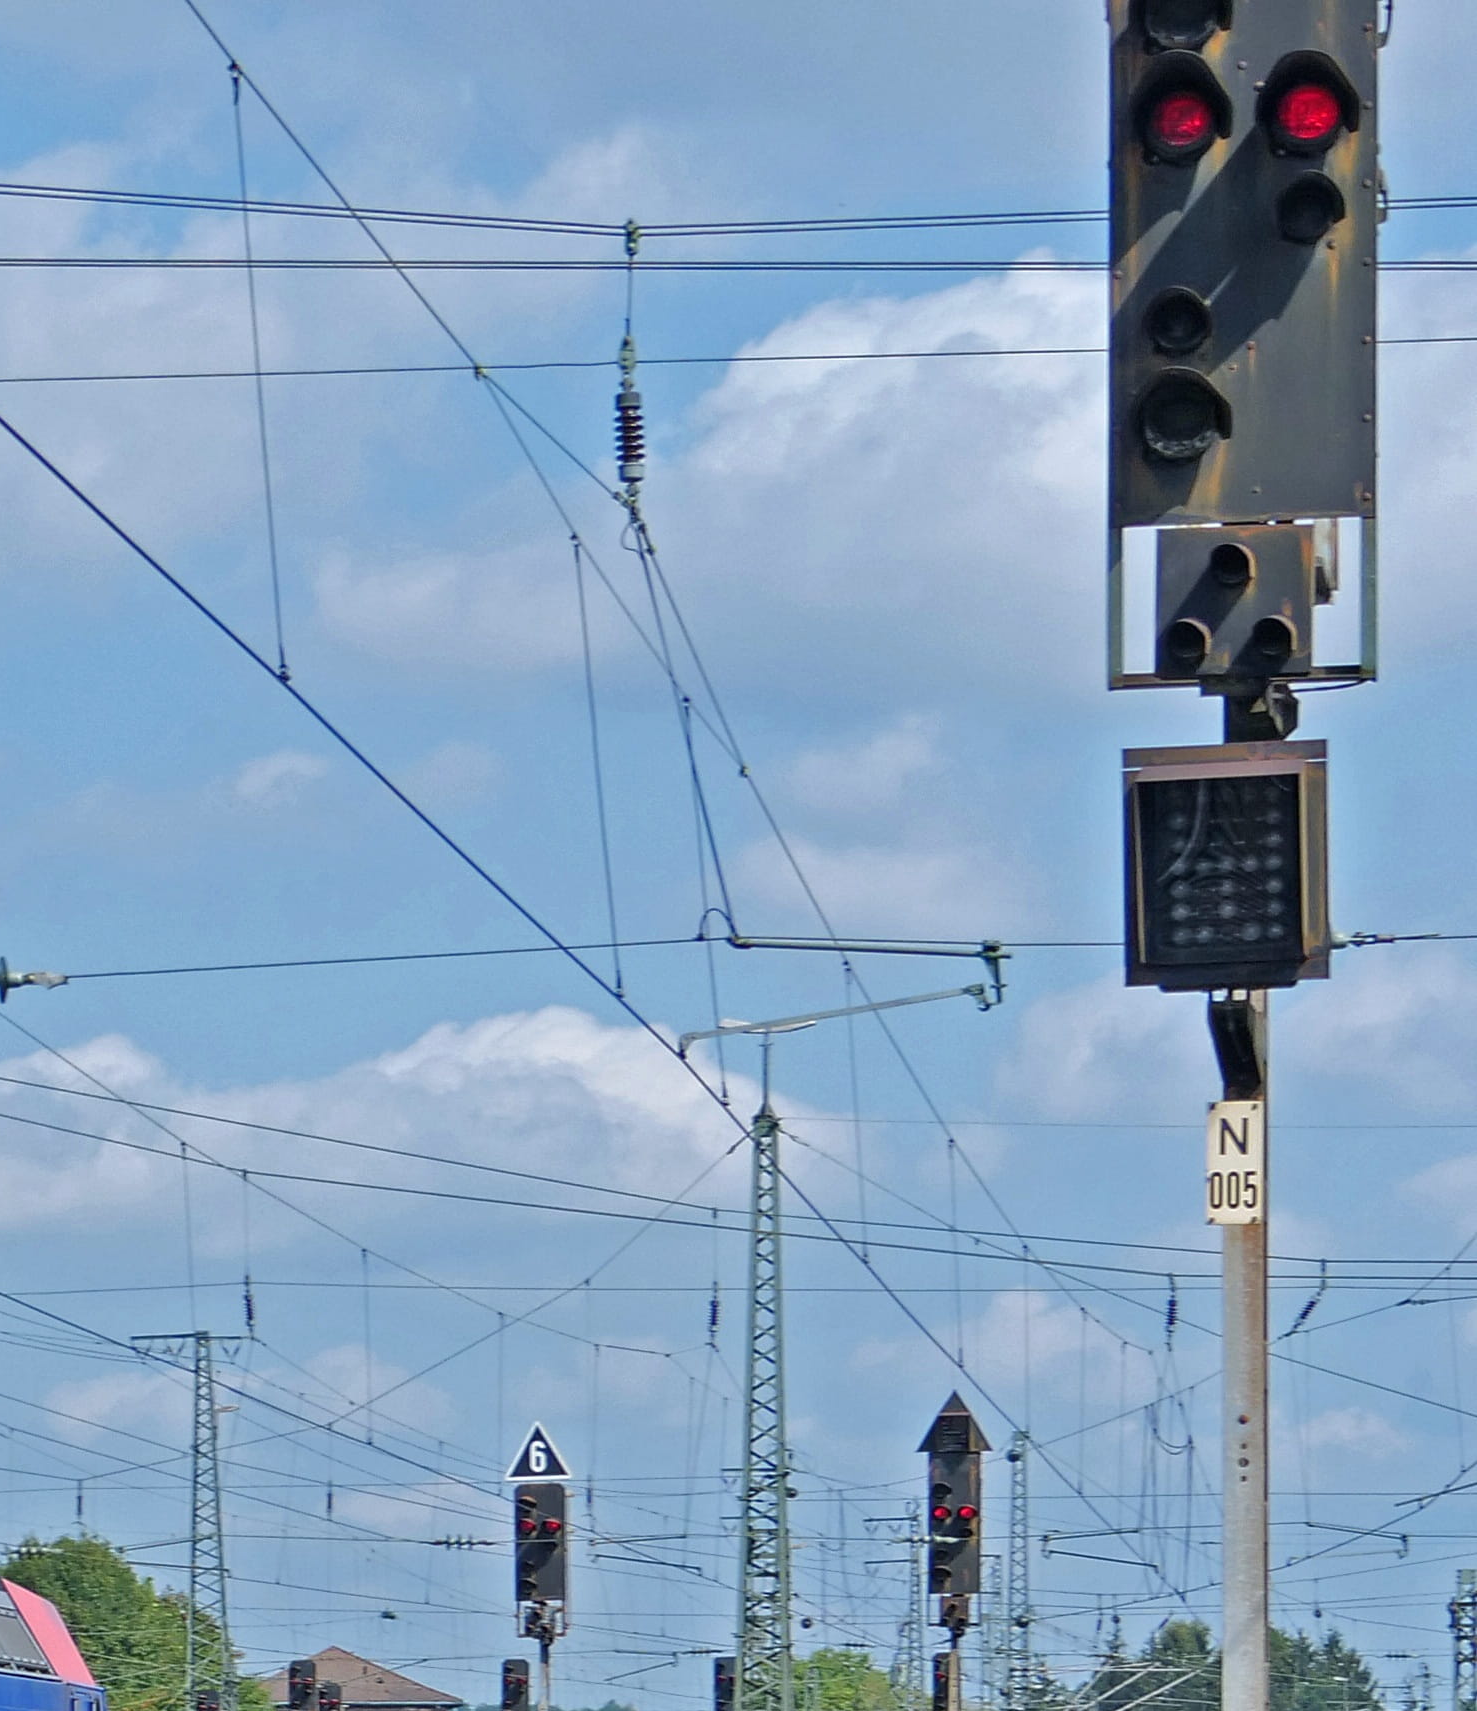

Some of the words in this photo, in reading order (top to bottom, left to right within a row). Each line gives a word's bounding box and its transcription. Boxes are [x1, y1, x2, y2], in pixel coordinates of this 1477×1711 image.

[1219, 1118, 1249, 1156] N
[1209, 1170, 1258, 1210] 005
[529, 1441, 547, 1473] 6
